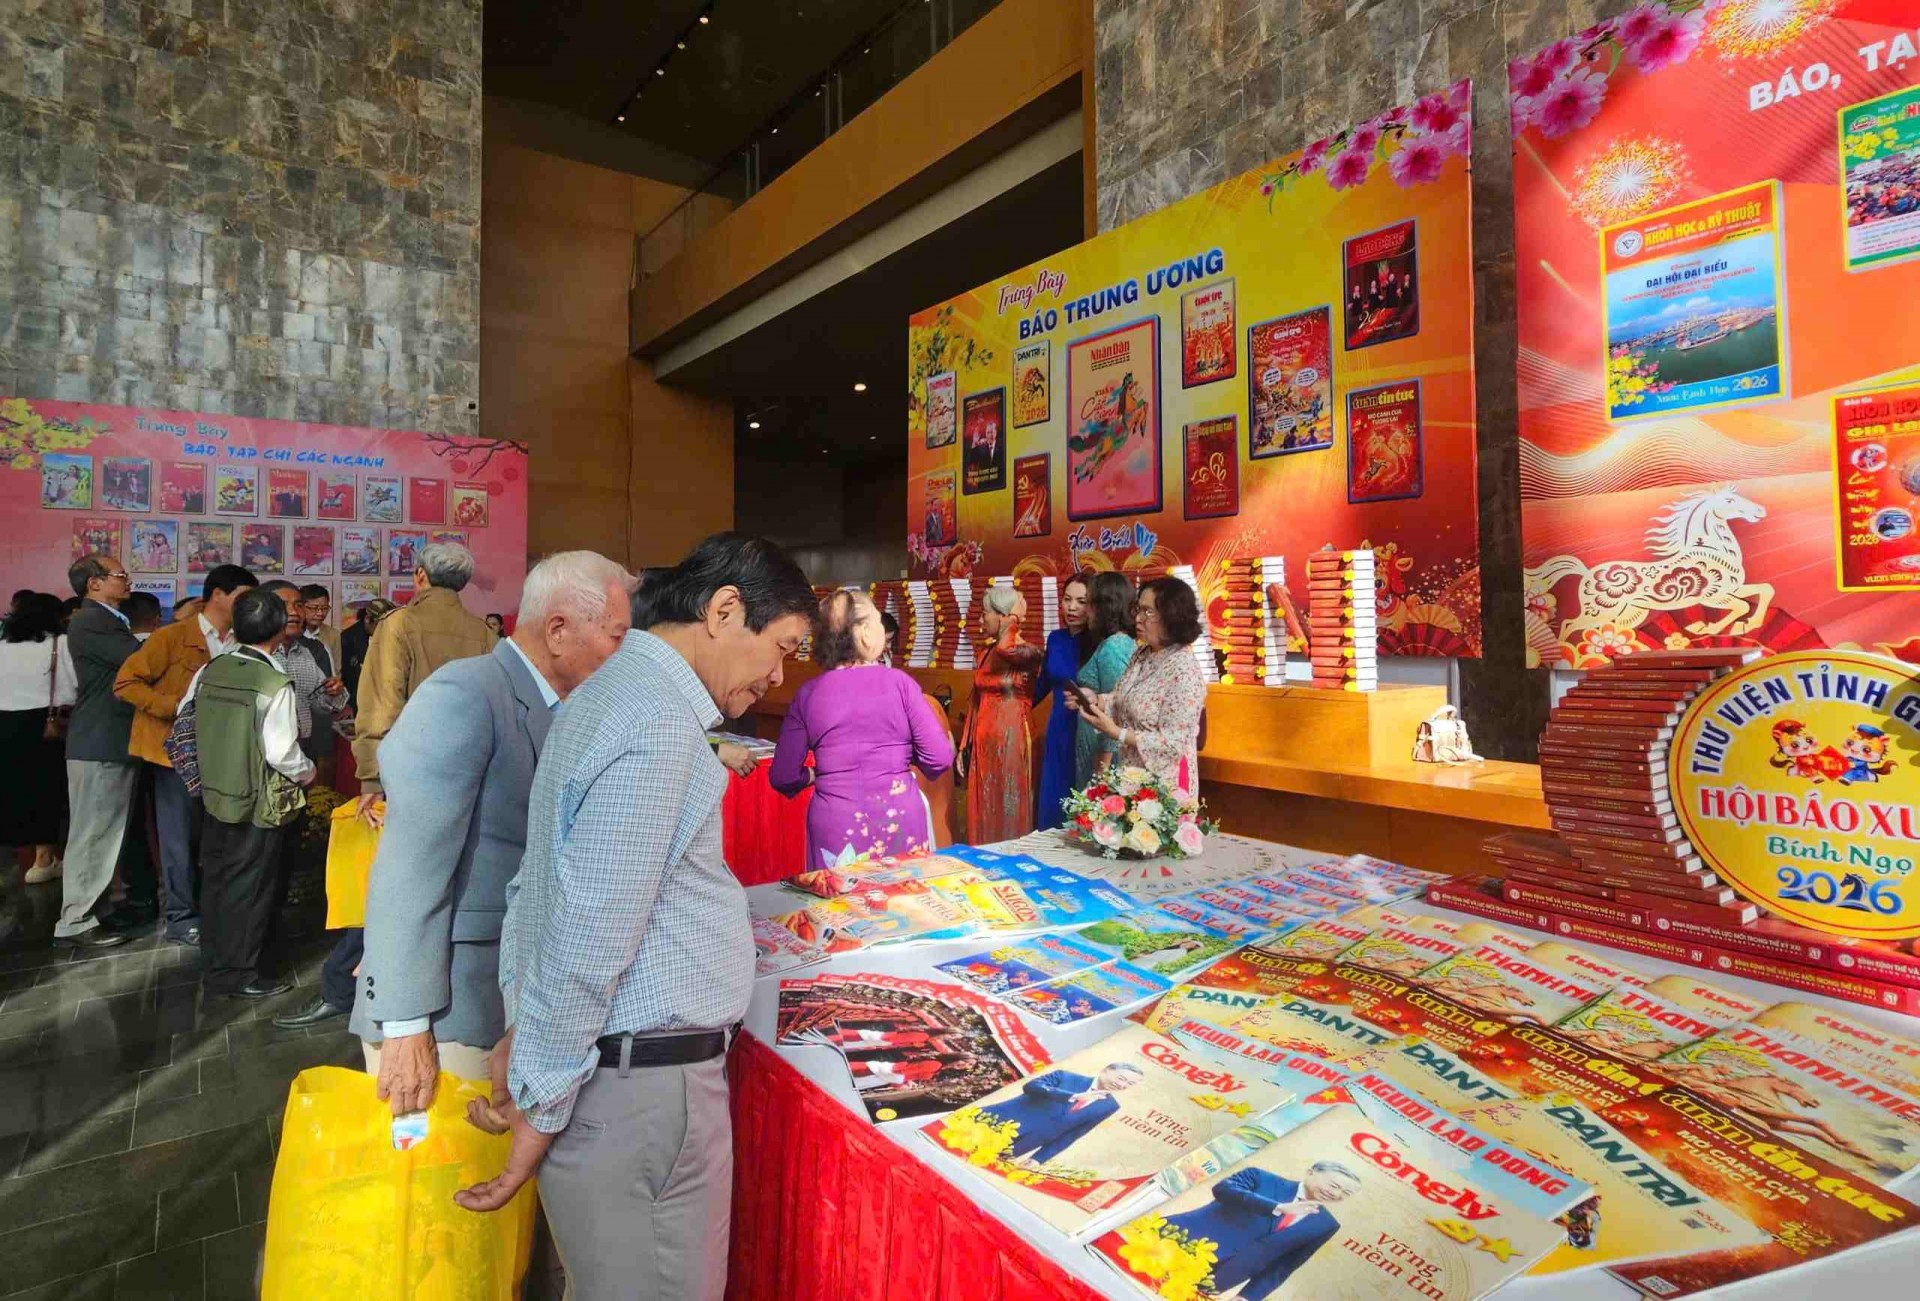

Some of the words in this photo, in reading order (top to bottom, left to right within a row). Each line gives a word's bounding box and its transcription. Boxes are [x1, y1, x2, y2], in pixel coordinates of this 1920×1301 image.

[1749, 62, 1842, 112] BÁO,
[1857, 27, 1920, 72] TẠ
[1019, 311, 1057, 340] BÁO
[1064, 279, 1138, 324] TRUNG
[1146, 248, 1225, 296] ƯƠNG
[1037, 269, 1067, 297] Bày
[1692, 718, 1732, 774] THƯ
[1717, 676, 1792, 727] VIỆN
[1797, 664, 1888, 709] TỈNH
[1894, 695, 1920, 731] G
[1700, 786, 1767, 826] HỘI
[1775, 793, 1859, 834] BÁO
[1767, 836, 1843, 864] Bính
[1850, 846, 1913, 875] Ngọ
[1199, 892, 1241, 910] GIA
[1776, 865, 1904, 916] 2026
[1159, 902, 1203, 921] GIA
[1202, 917, 1248, 934] LAI
[1241, 1044, 1288, 1064] LAO
[1119, 1114, 1163, 1140] niềm
[1146, 1109, 1192, 1135] Vững
[1428, 1117, 1487, 1152] LAO
[1659, 1086, 1755, 1147] tuần
[1748, 1140, 1819, 1181] tin
[1814, 1174, 1906, 1222] tức
[1342, 1236, 1404, 1277] niềm
[1406, 1273, 1446, 1301] tin
[1376, 1231, 1443, 1279] Vững
